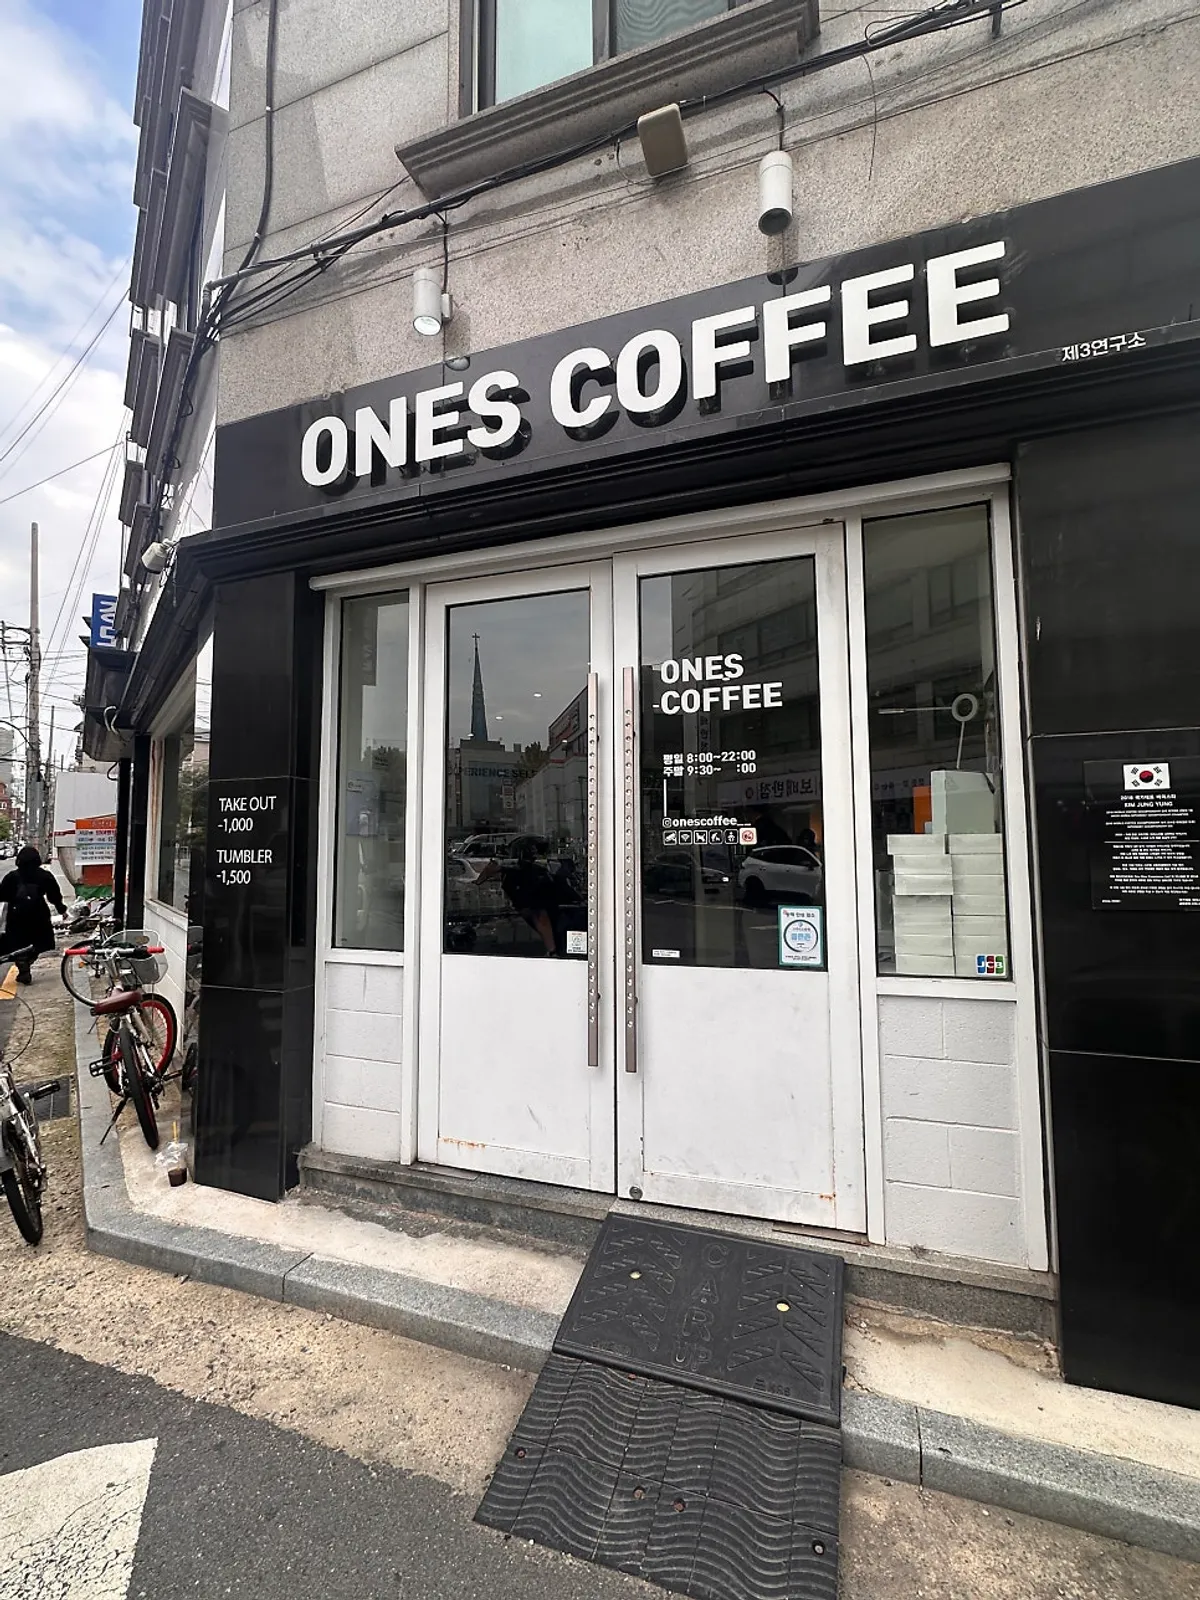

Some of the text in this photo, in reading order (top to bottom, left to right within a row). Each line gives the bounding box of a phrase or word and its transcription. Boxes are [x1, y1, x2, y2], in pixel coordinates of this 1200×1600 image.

[1061, 332, 1146, 362] 제3연구소
[301, 240, 1010, 486] ONES COFFEE
[660, 653, 744, 683] ONES
[660, 682, 783, 715] COFFEE
[663, 749, 756, 765] 평일 8:00~22:00
[663, 765, 684, 777] 주말
[218, 796, 277, 812] TAKE OUT
[217, 817, 254, 834] -1,000
[216, 849, 273, 864] TUMBLER
[216, 869, 251, 886] -1,500
